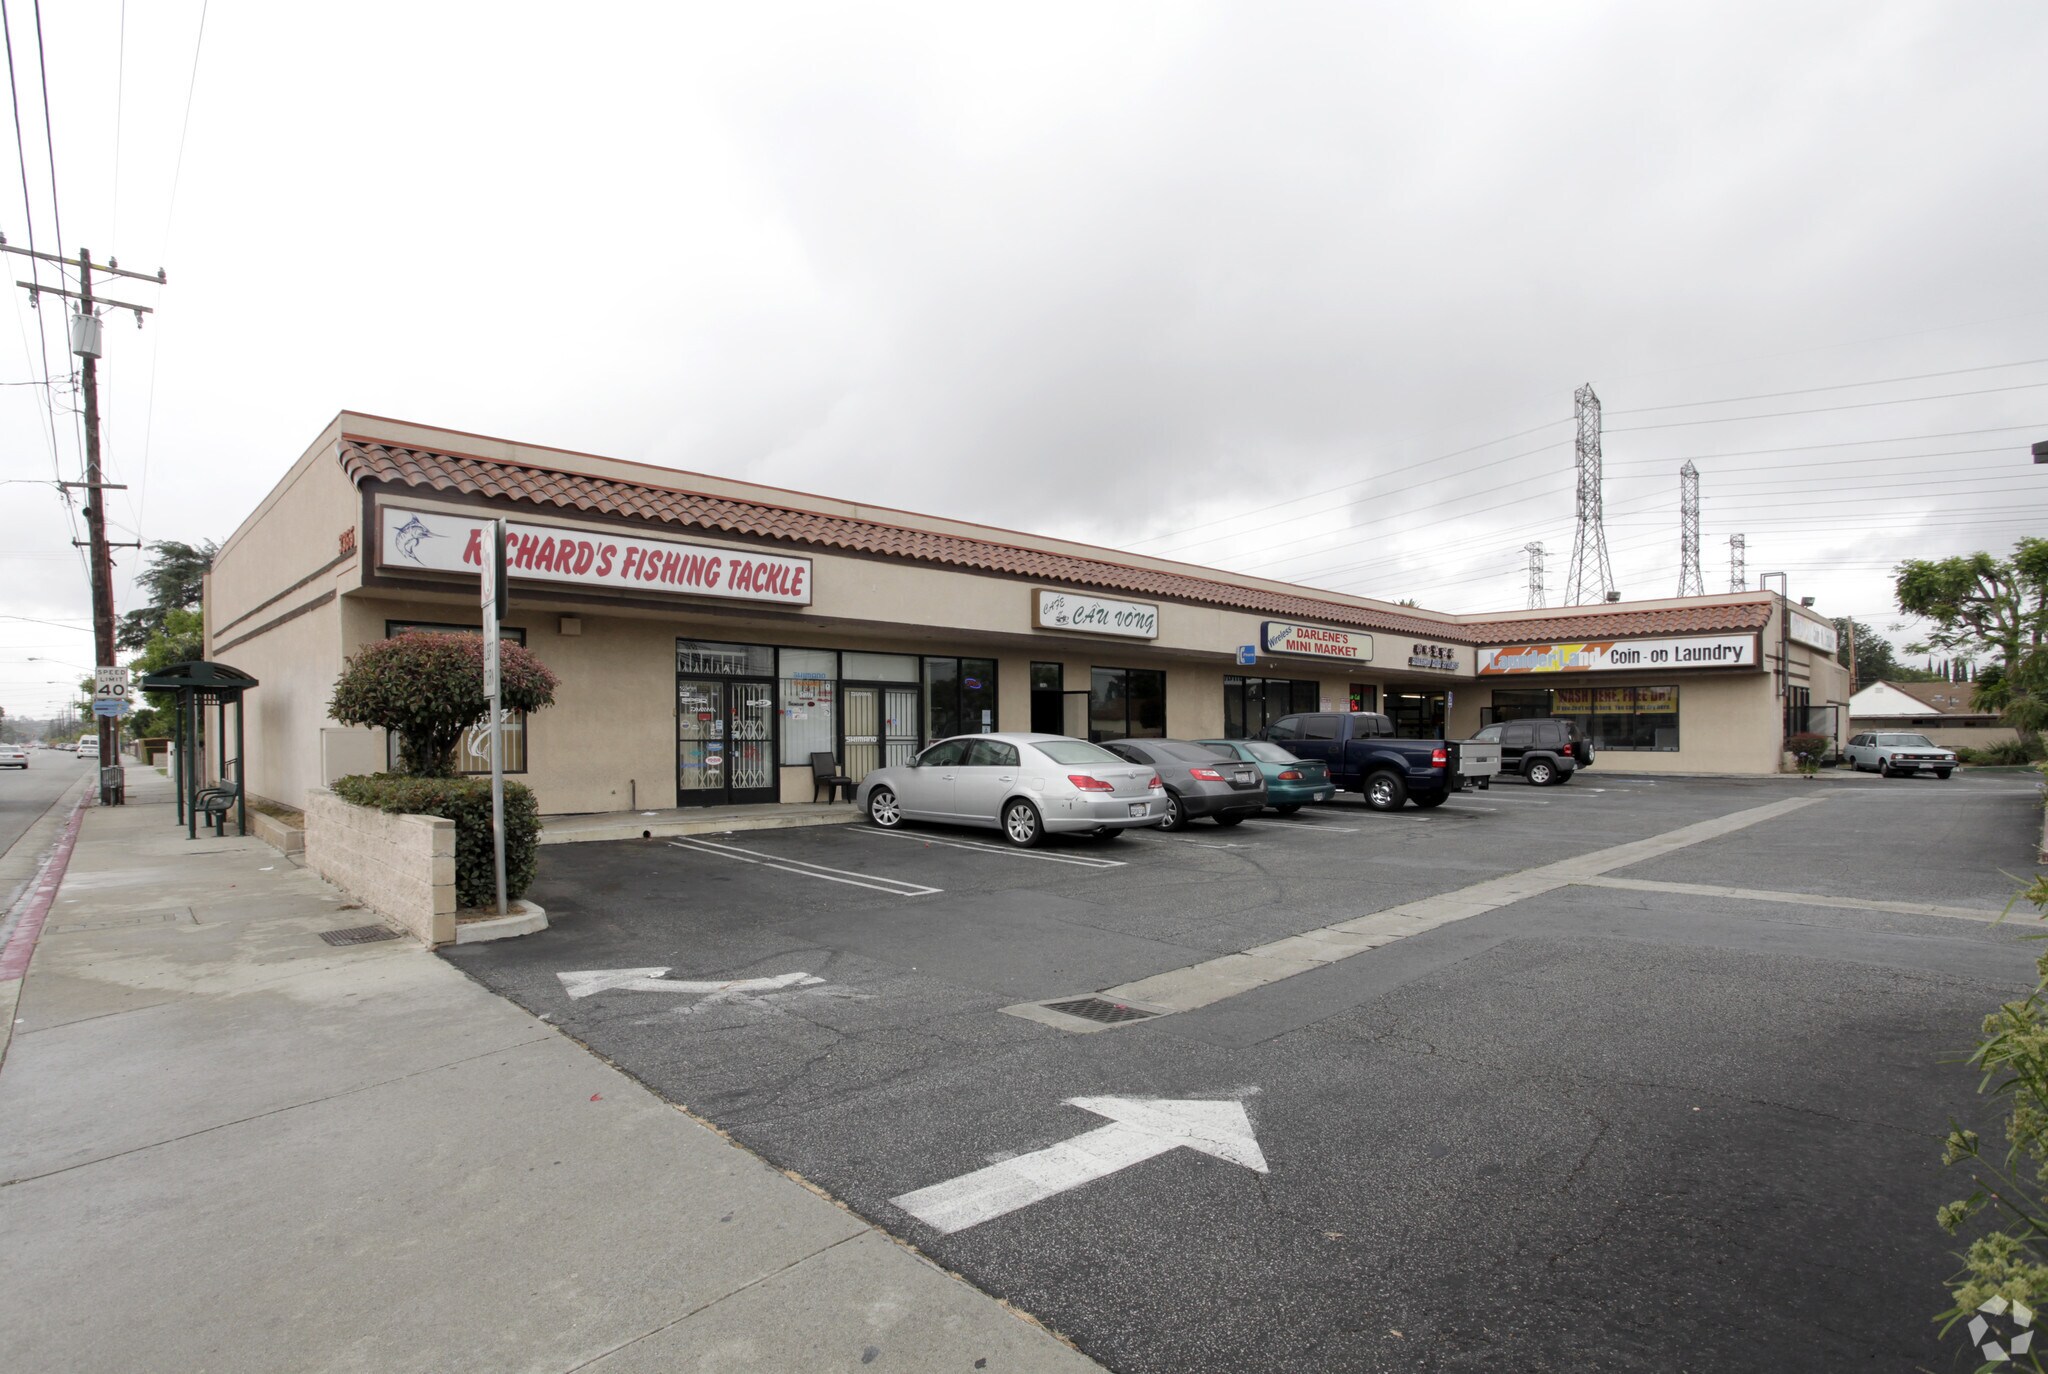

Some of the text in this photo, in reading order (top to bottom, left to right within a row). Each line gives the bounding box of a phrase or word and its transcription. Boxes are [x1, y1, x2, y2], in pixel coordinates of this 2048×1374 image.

[463, 529, 805, 597] RCHARD'S FISHING TACKLE
[1268, 625, 1293, 648] Wireless
[1296, 627, 1349, 645] DARLENE'S
[1286, 639, 1358, 657] MINI MARKET
[1610, 649, 1640, 664] Coin
[1675, 644, 1744, 663] Laundry
[98, 684, 125, 696] 40
